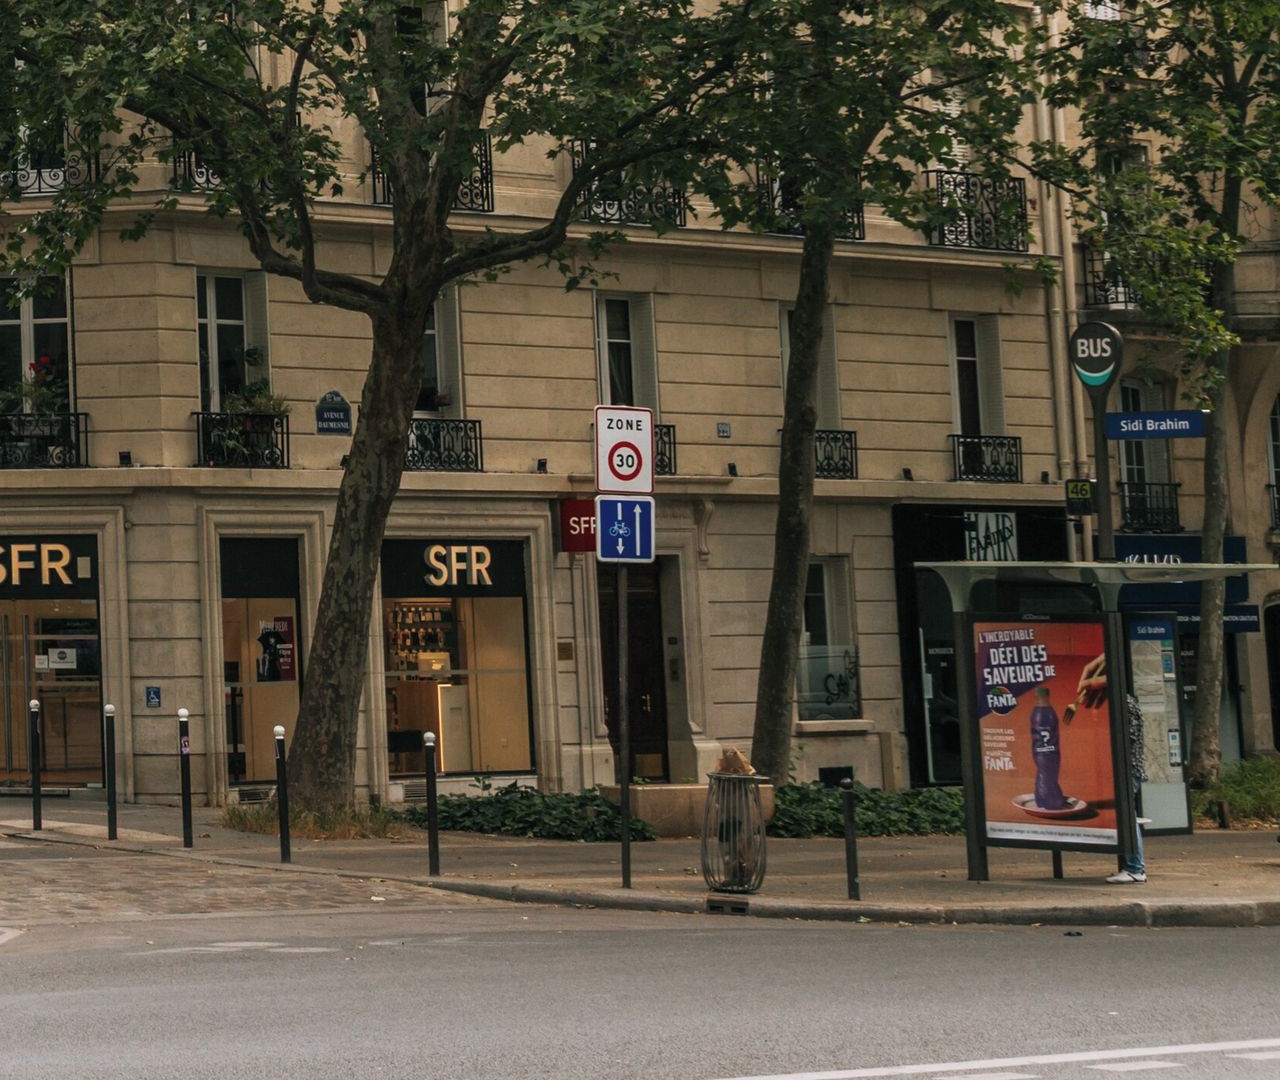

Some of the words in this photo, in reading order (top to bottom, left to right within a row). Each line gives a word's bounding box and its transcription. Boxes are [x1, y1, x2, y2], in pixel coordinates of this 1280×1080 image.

[1077, 338, 1112, 358] BUS
[606, 418, 643, 431] ZONE
[1120, 419, 1143, 432] Sidi
[1146, 418, 1190, 431] Brahim
[616, 453, 635, 469] 30
[1070, 483, 1089, 497] 46
[425, 544, 493, 587] SFR
[979, 628, 1035, 644] L'INCROYABLE
[989, 643, 1018, 665] DÉFI
[1021, 644, 1048, 663] DES
[983, 664, 1044, 686] SAVEURS
[1044, 665, 1056, 677] DE
